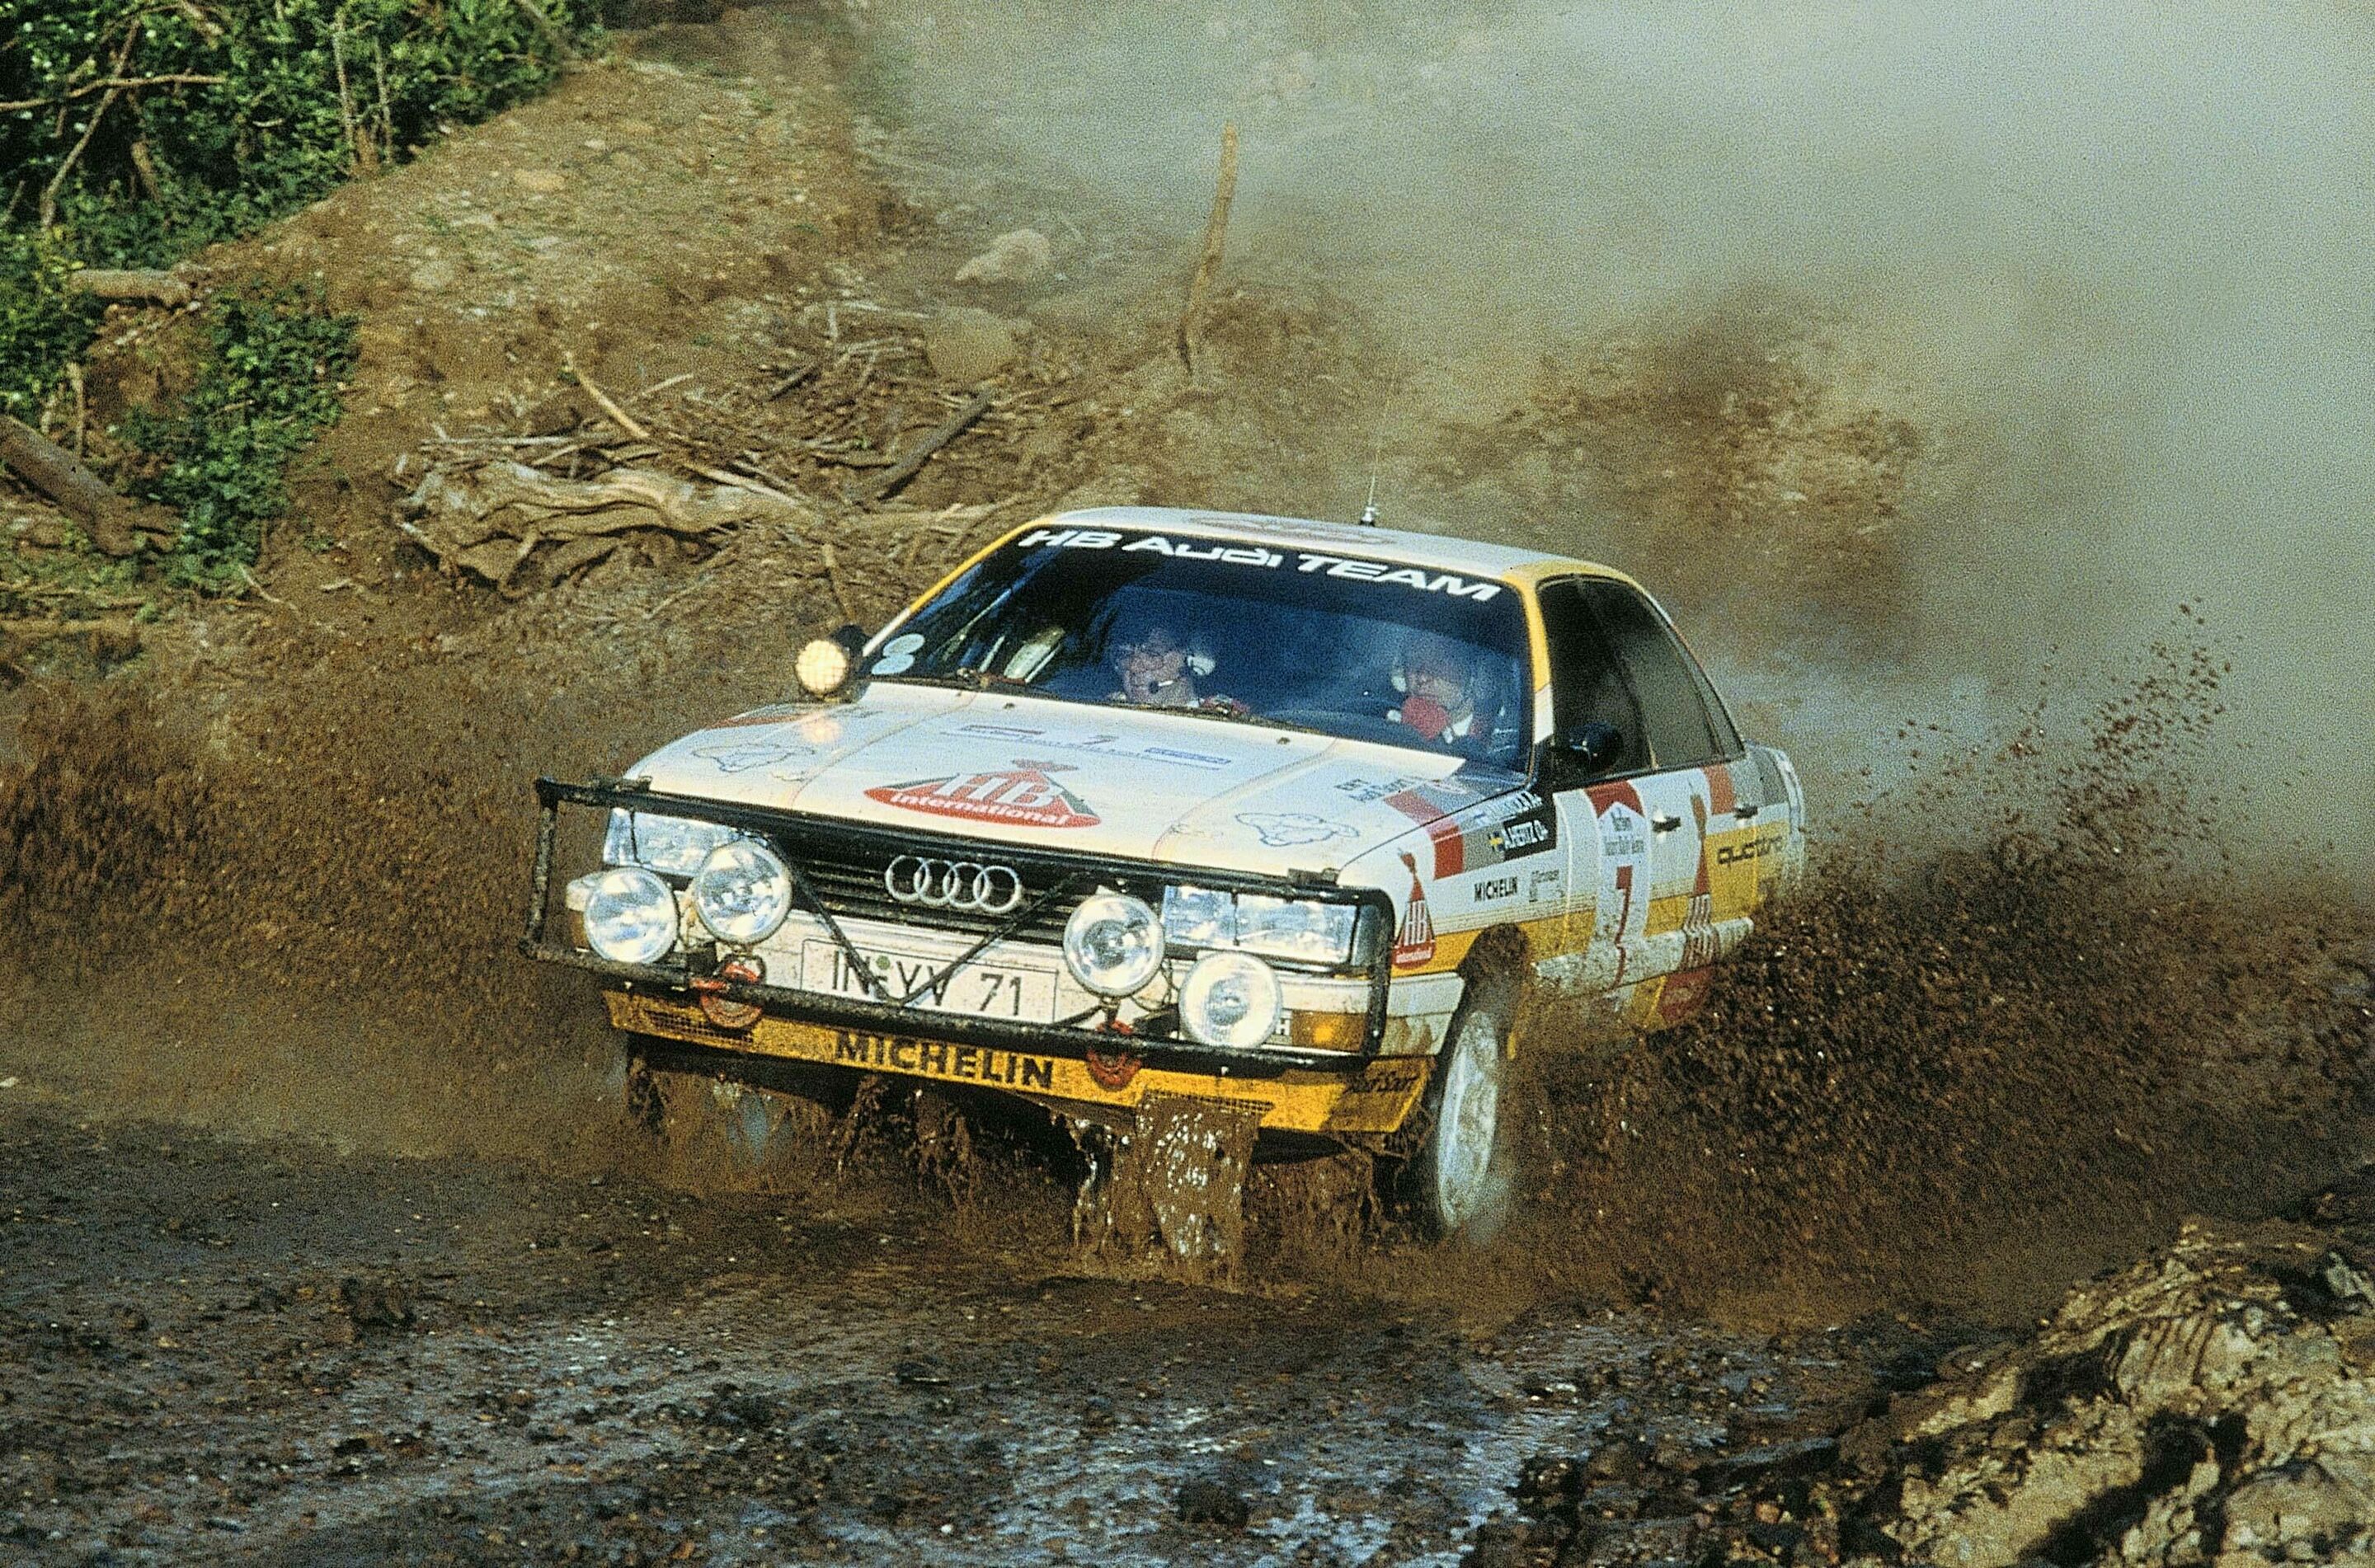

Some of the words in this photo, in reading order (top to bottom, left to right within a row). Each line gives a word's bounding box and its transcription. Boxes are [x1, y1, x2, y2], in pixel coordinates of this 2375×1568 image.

[1018, 530, 1122, 548] HB
[1295, 553, 1502, 603] TEAM
[933, 773, 1063, 808] HB
[1474, 876, 1517, 903] MICHELIN
[1404, 899, 1427, 946] HB
[980, 971, 1023, 1016] 71
[835, 1030, 1054, 1089] MICHELIN
